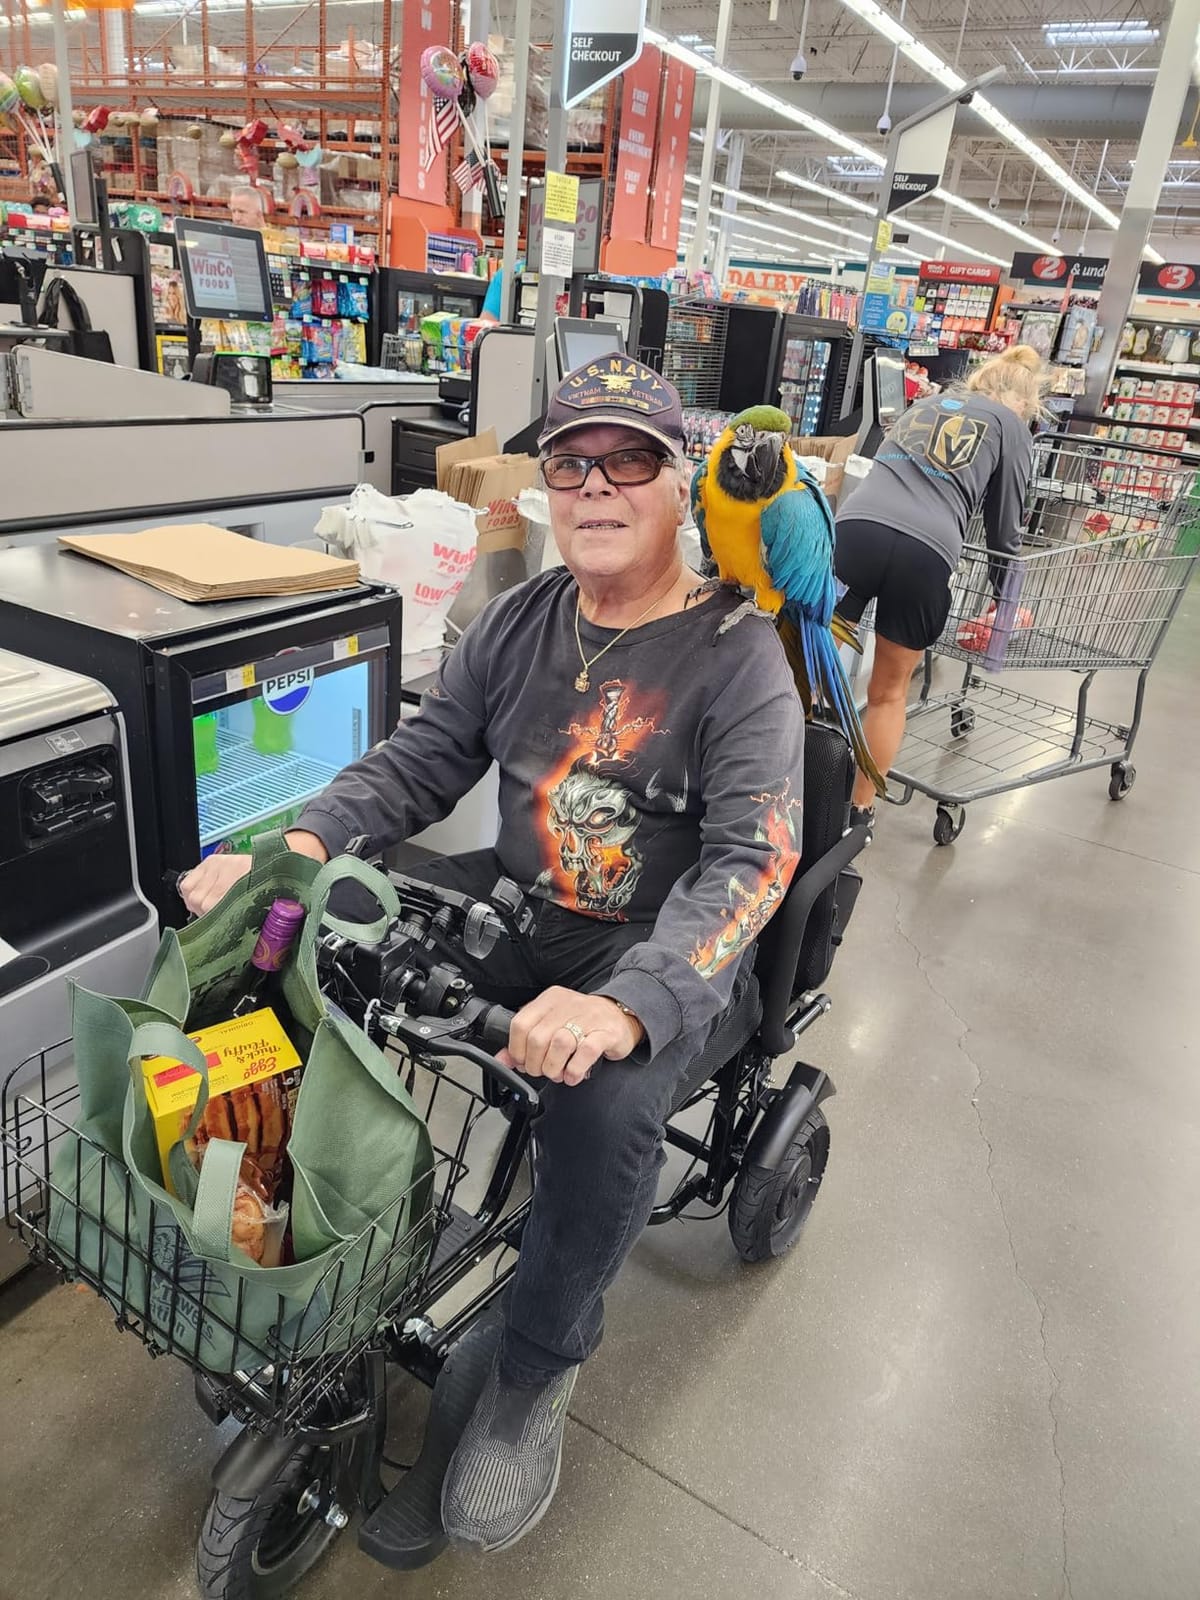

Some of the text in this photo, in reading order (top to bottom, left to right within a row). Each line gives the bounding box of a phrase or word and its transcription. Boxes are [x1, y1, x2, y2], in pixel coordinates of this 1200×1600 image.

[572, 37, 594, 48] SELF
[571, 50, 622, 62] CHECKOUT
[894, 174, 910, 182] SELF
[892, 182, 928, 192] CHECKOUT
[191, 258, 234, 278] WinCo
[1070, 263, 1081, 275] &
[1082, 264, 1108, 277] und
[199, 278, 230, 290] FOODS
[728, 269, 807, 294] DAIRY
[569, 359, 663, 391] U.S. NAVY
[568, 387, 663, 407] VIETNAM VETERAN
[266, 667, 311, 694] PEPSI
[220, 1021, 254, 1035] ORIGINAL
[223, 1038, 270, 1058] Fluffy
[247, 1045, 281, 1060] Thick
[243, 1056, 277, 1081] Eggo
